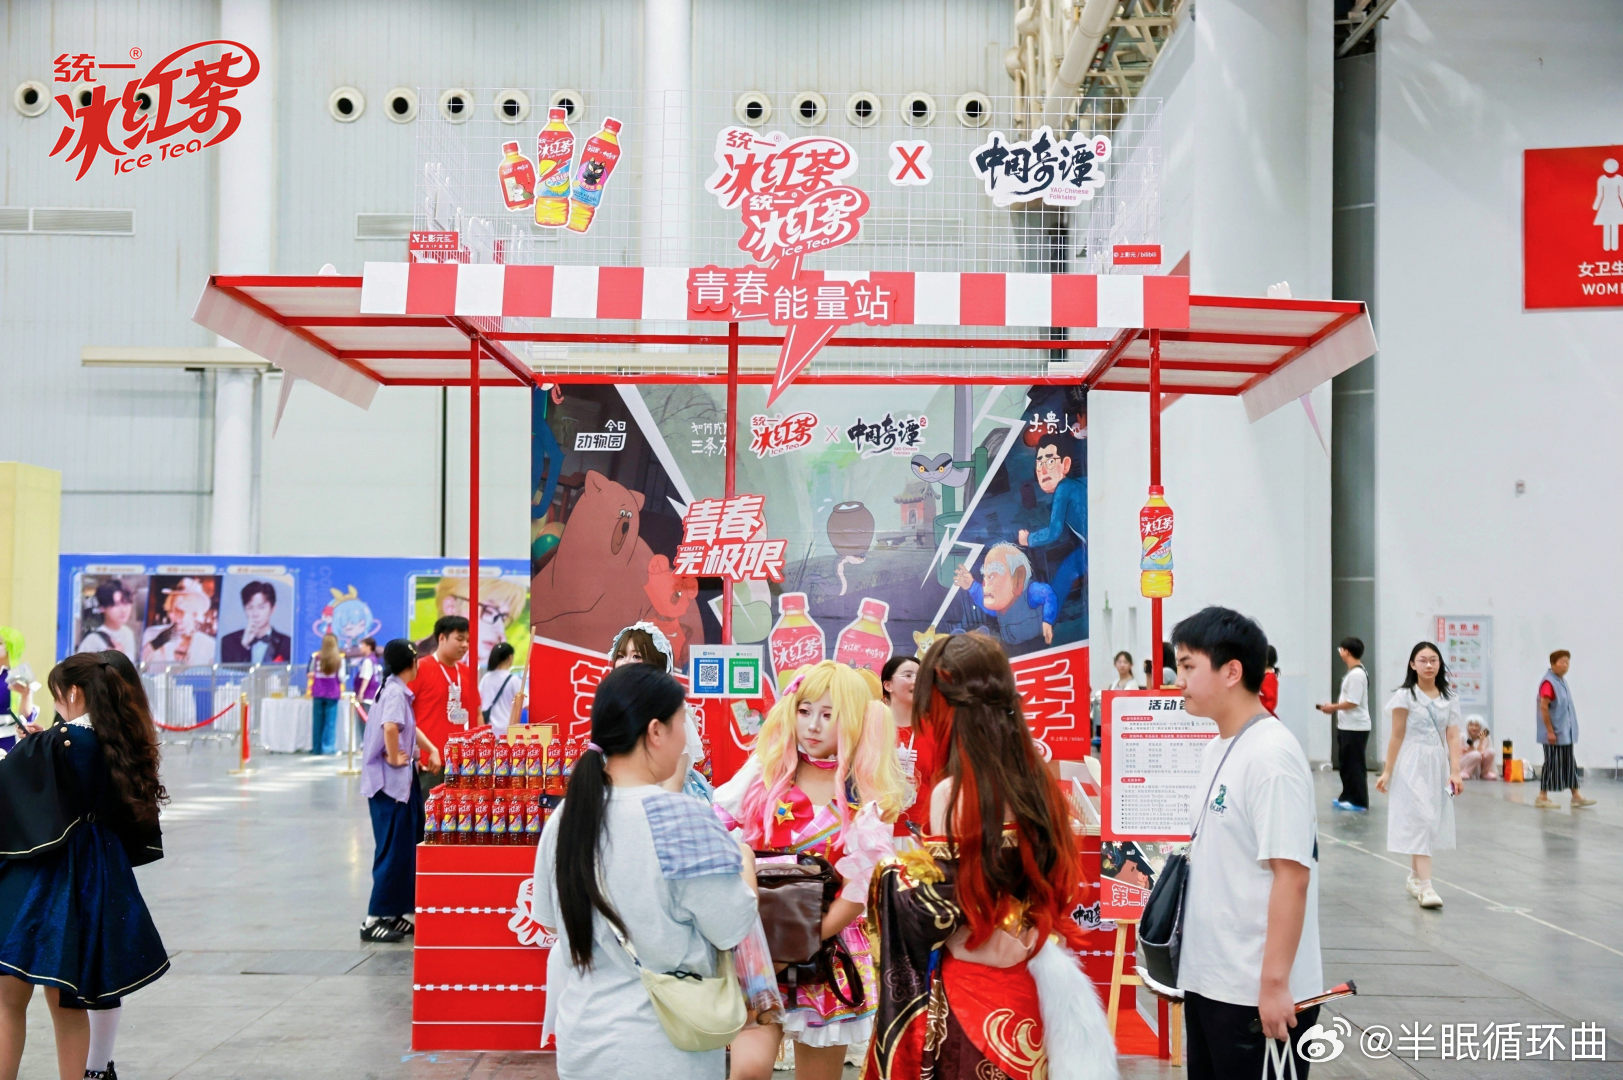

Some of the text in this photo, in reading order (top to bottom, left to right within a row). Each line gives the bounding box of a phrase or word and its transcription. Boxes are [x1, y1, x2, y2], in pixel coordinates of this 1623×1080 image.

[726, 130, 776, 150] 统一
[713, 138, 851, 207] 冰红茶
[749, 194, 795, 211] 统一
[745, 187, 862, 260] 冰红茶
[782, 237, 831, 257] Ice Tea
[1577, 261, 1623, 278] 女卫生
[1582, 283, 1623, 295] WOM
[605, 419, 626, 432] 今日
[751, 412, 818, 457] 冰红茶
[577, 434, 624, 449] 动物园
[685, 495, 764, 548] 青春
[674, 541, 785, 580] 无极限
[773, 634, 822, 670] 冰红茶
